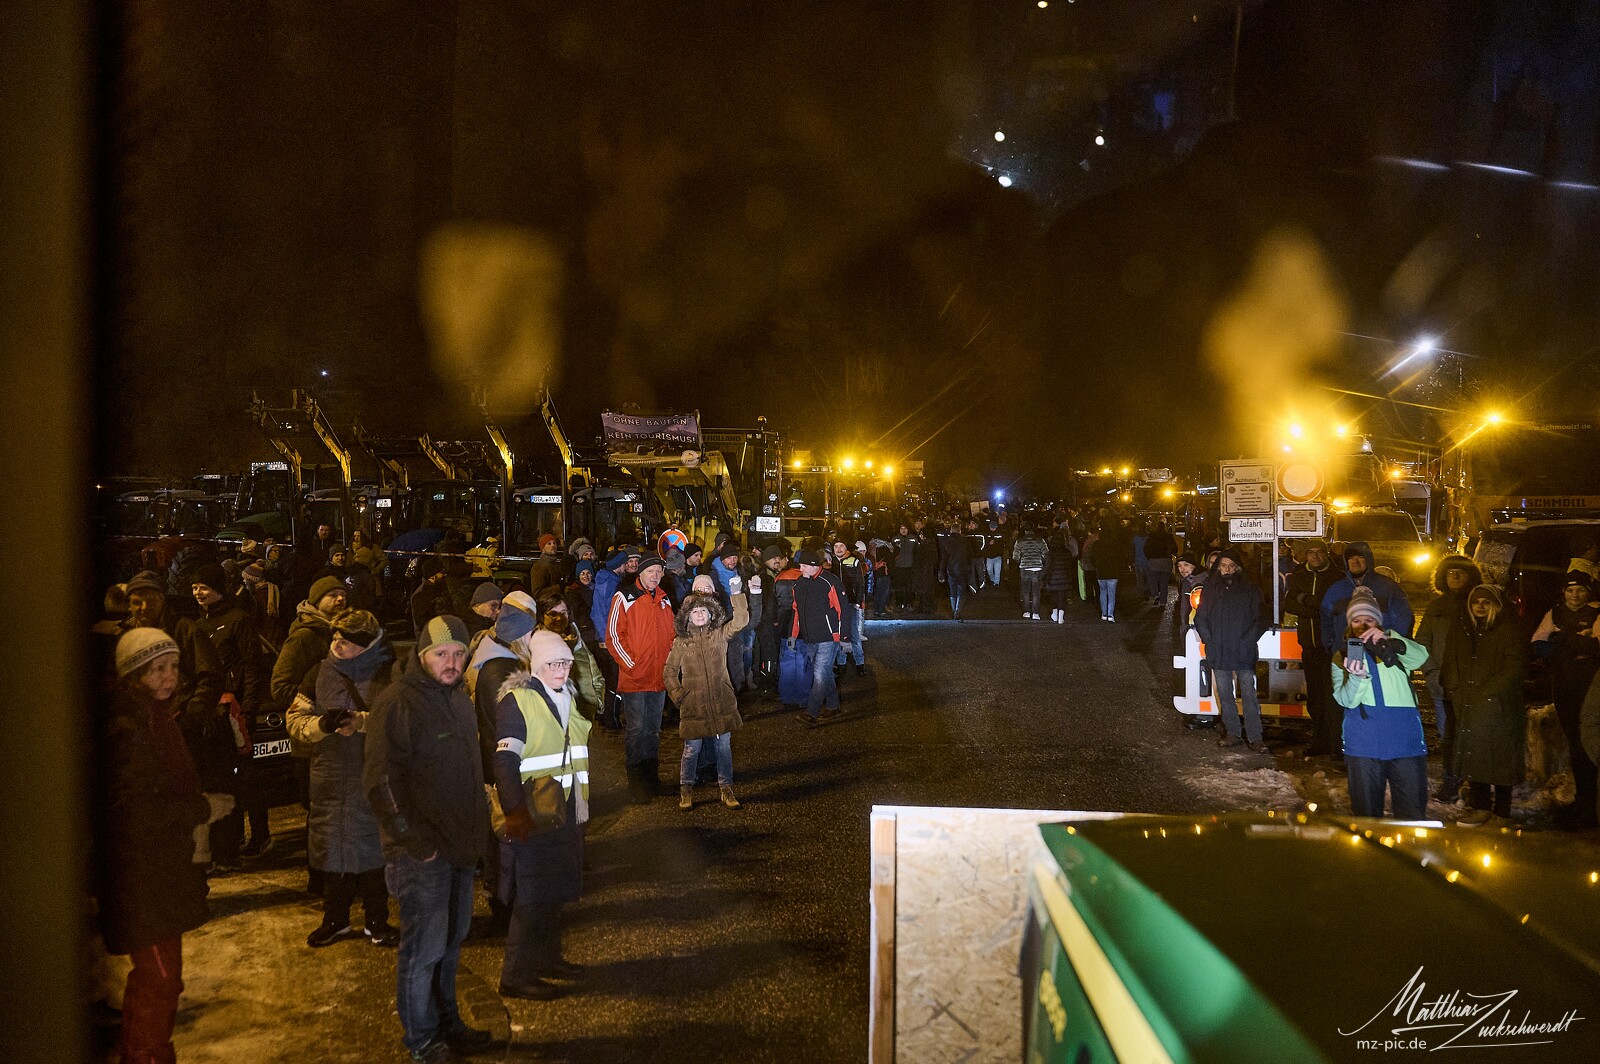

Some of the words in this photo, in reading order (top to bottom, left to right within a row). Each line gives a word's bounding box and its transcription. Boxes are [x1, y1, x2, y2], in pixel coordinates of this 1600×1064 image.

[613, 416, 640, 426] OHNE
[646, 418, 688, 426] BAUERN
[634, 432, 696, 443] TOURISMUS!
[1239, 520, 1262, 528] Zufahrt
[253, 743, 272, 756] BGL
